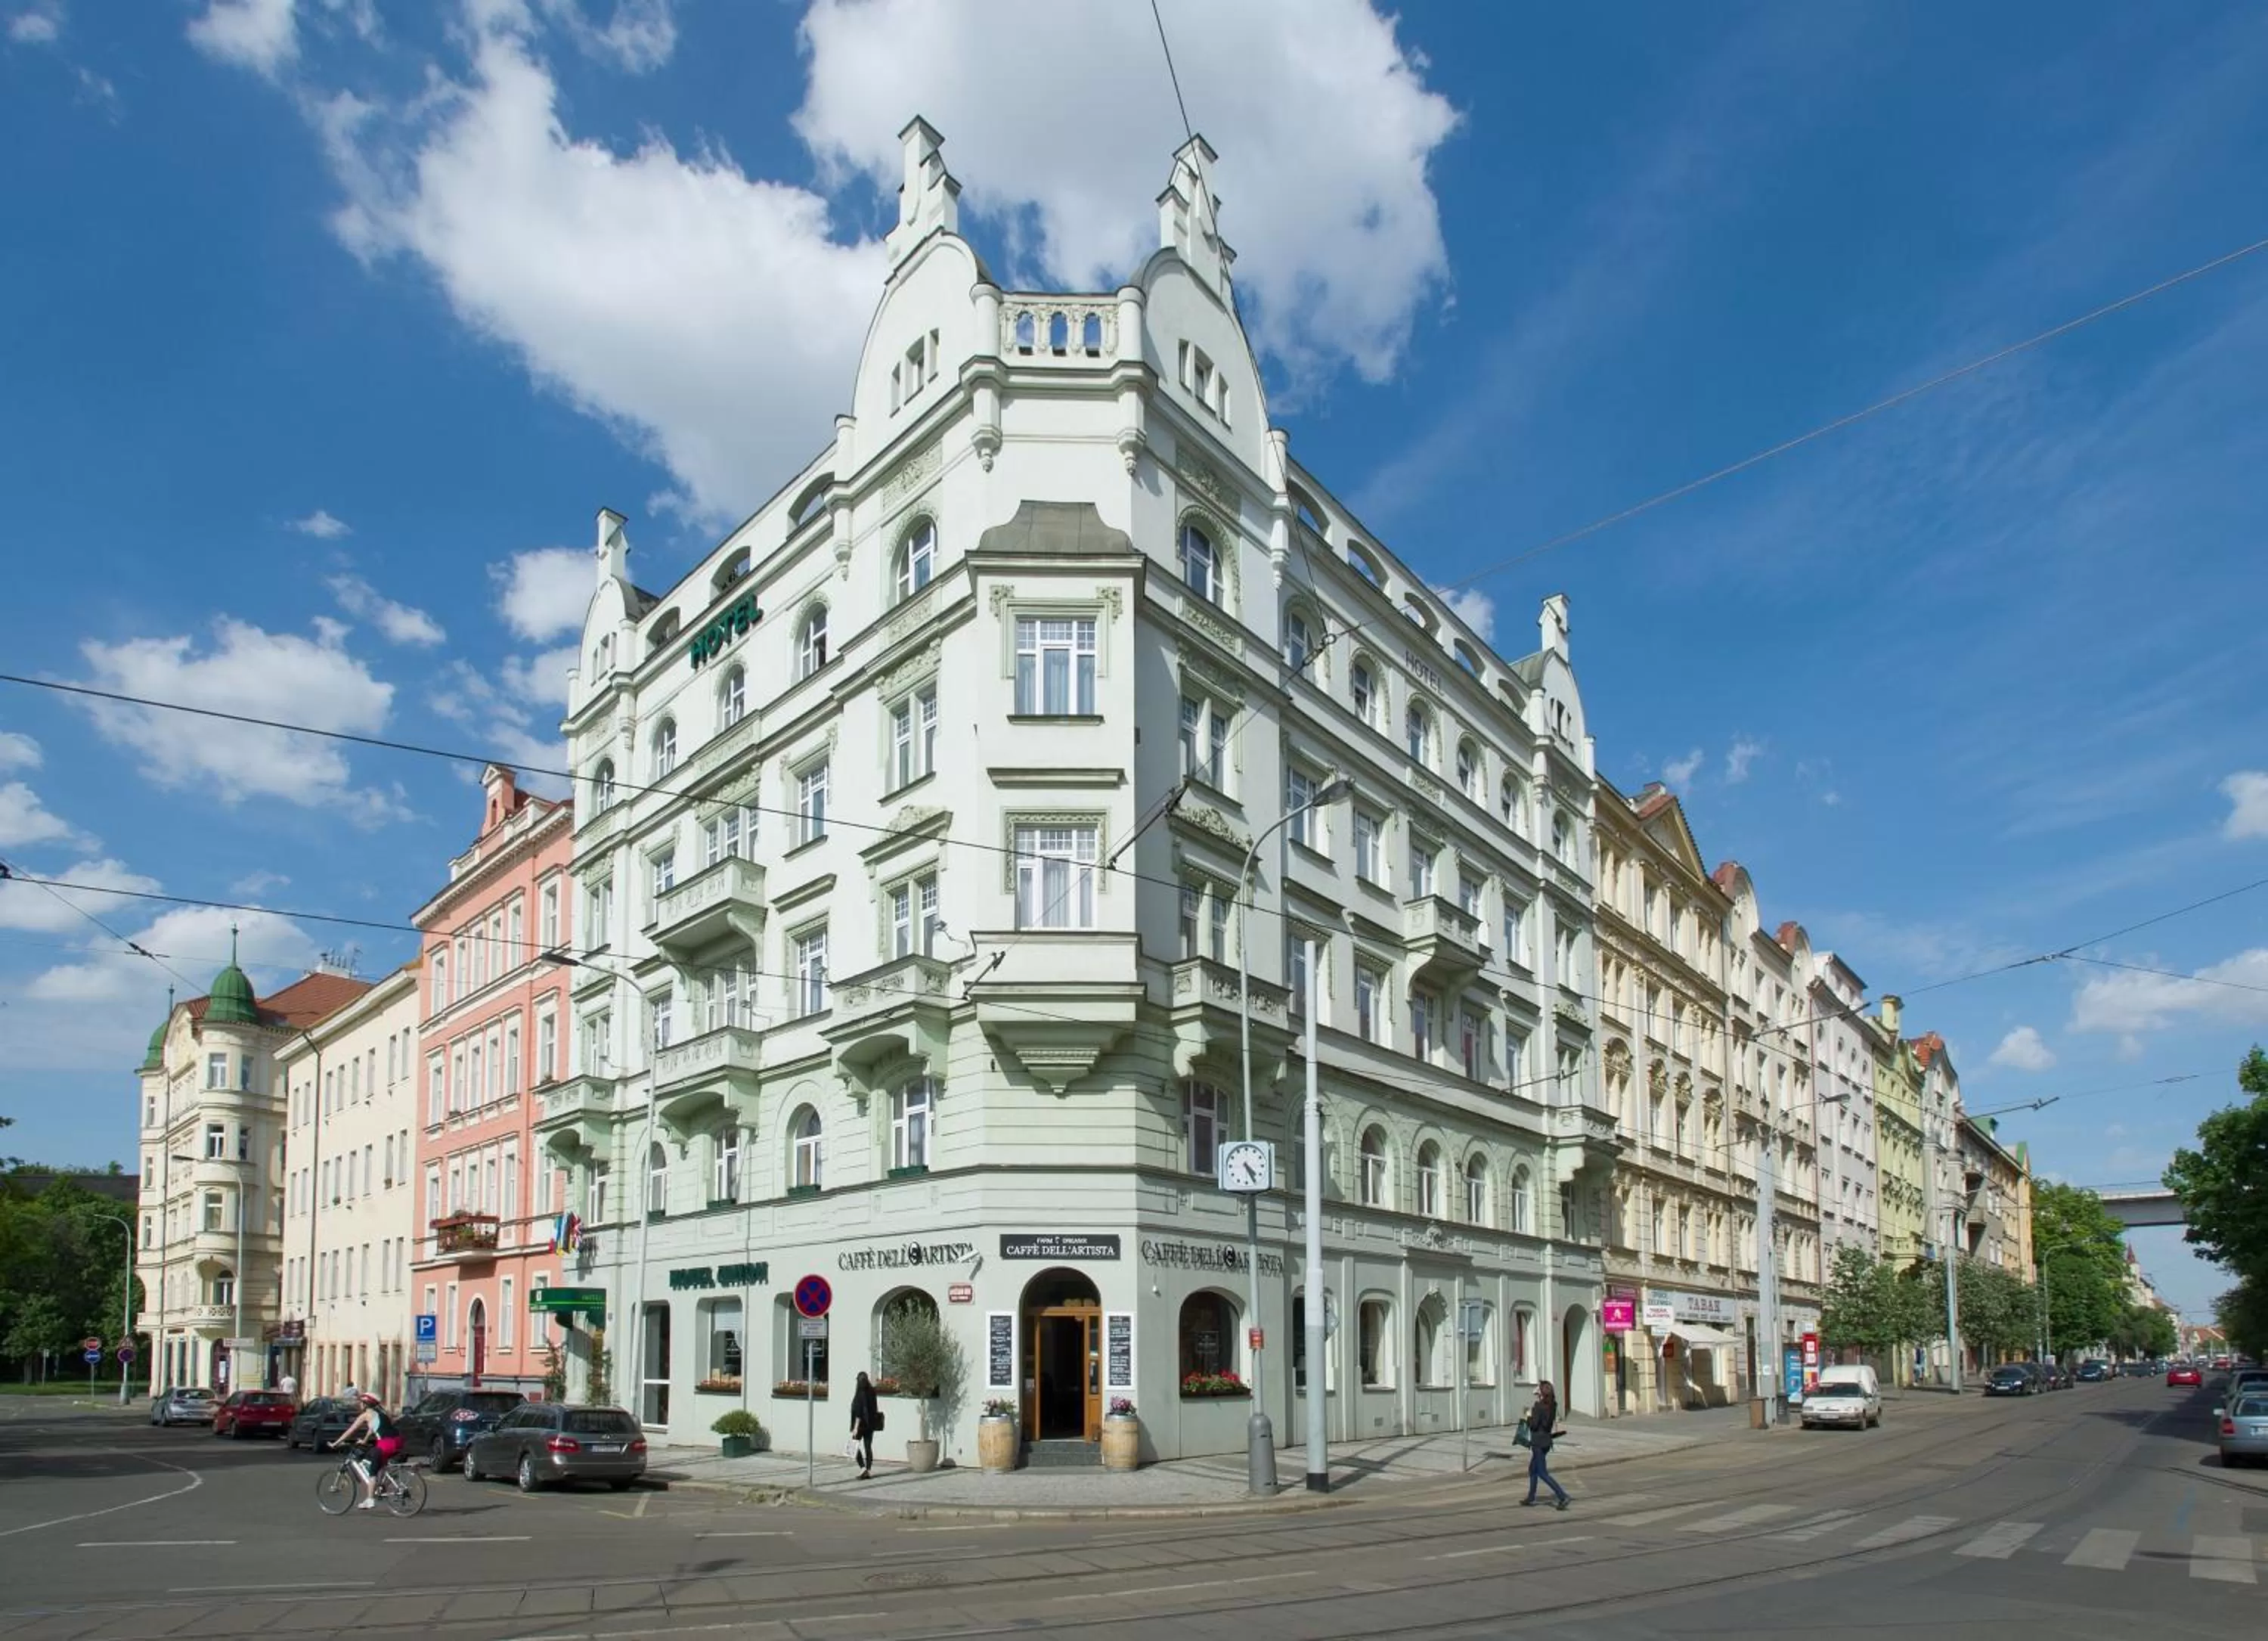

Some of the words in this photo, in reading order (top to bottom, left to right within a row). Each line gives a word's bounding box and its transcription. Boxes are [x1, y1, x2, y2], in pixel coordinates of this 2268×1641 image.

[690, 594, 764, 669] HOTEL
[1406, 650, 1444, 696] HOTEL
[1006, 1242, 1040, 1255] CAFFÈ
[420, 1318, 433, 1335] P
